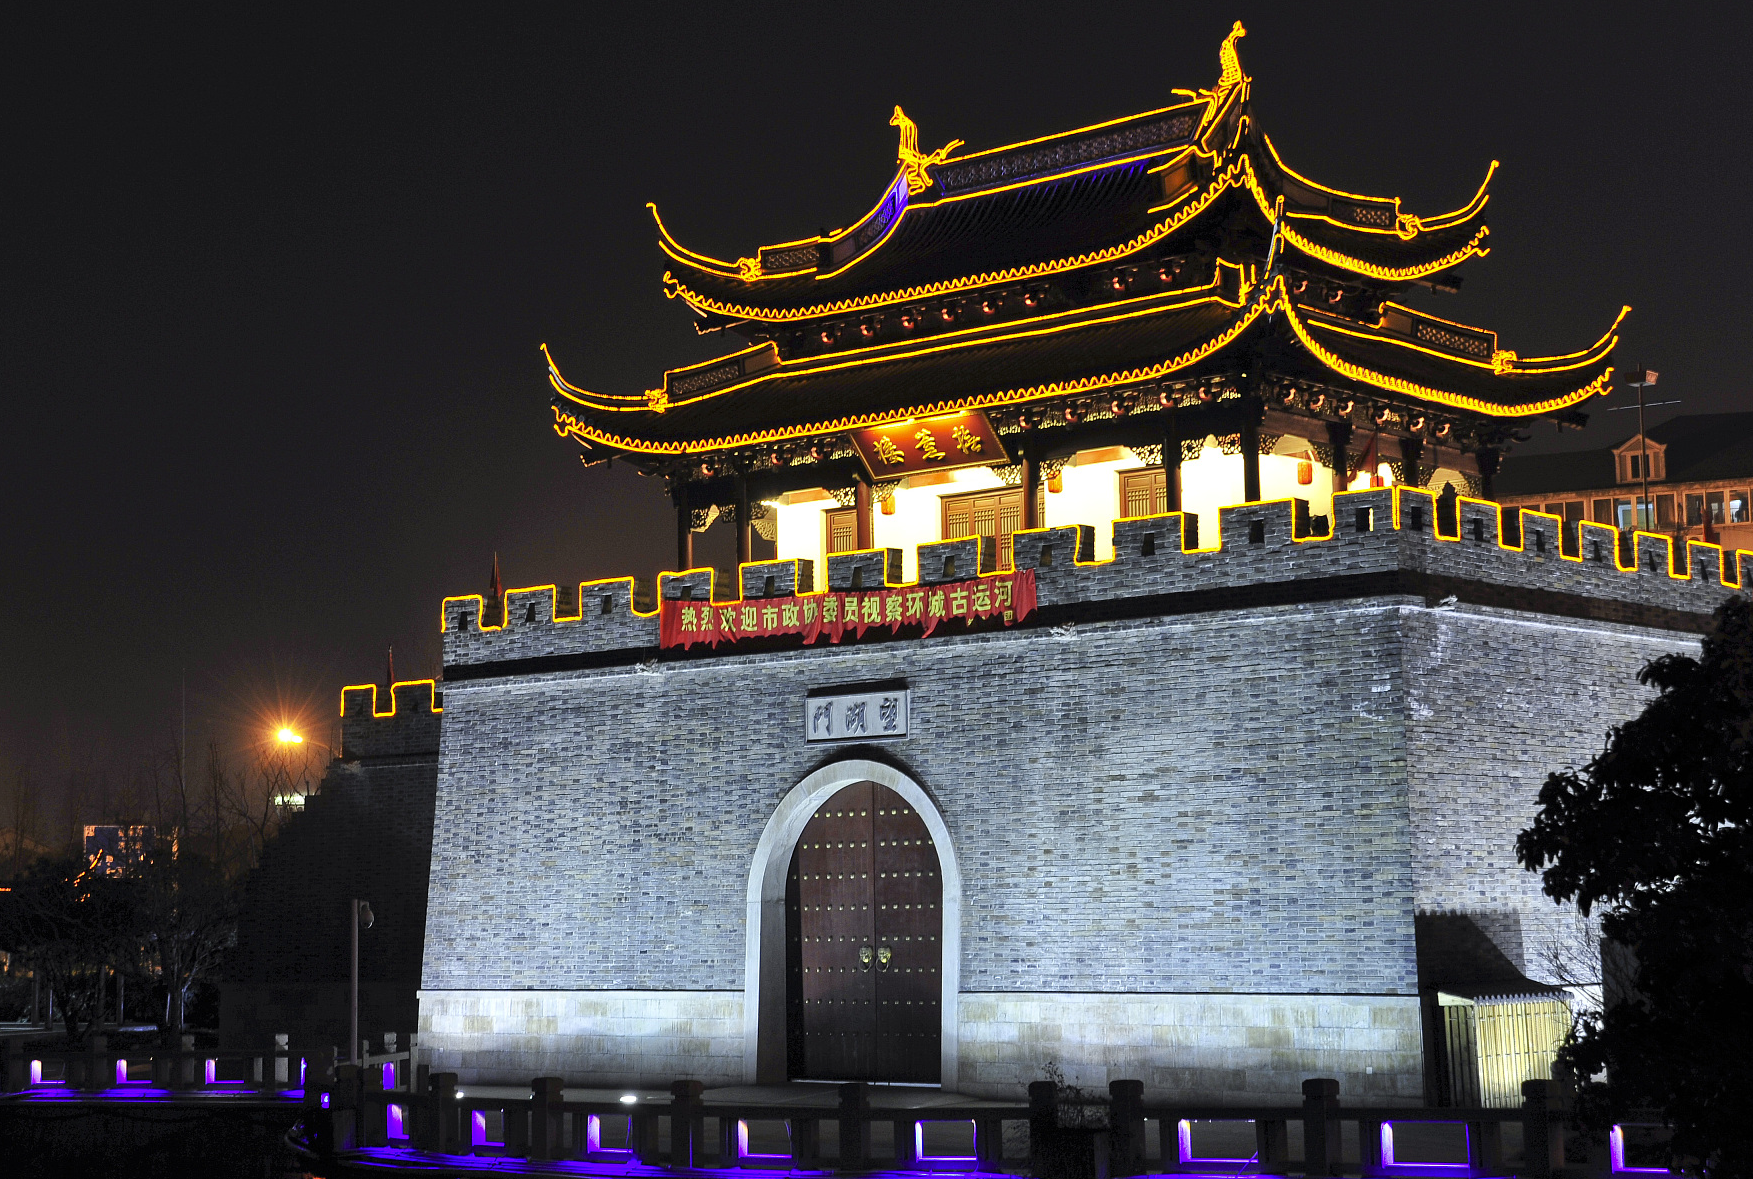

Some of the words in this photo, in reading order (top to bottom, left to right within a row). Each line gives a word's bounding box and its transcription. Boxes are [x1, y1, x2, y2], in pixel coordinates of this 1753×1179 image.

[681, 581, 1012, 632] 热烈欢迎市政协委员视察环城古运河
